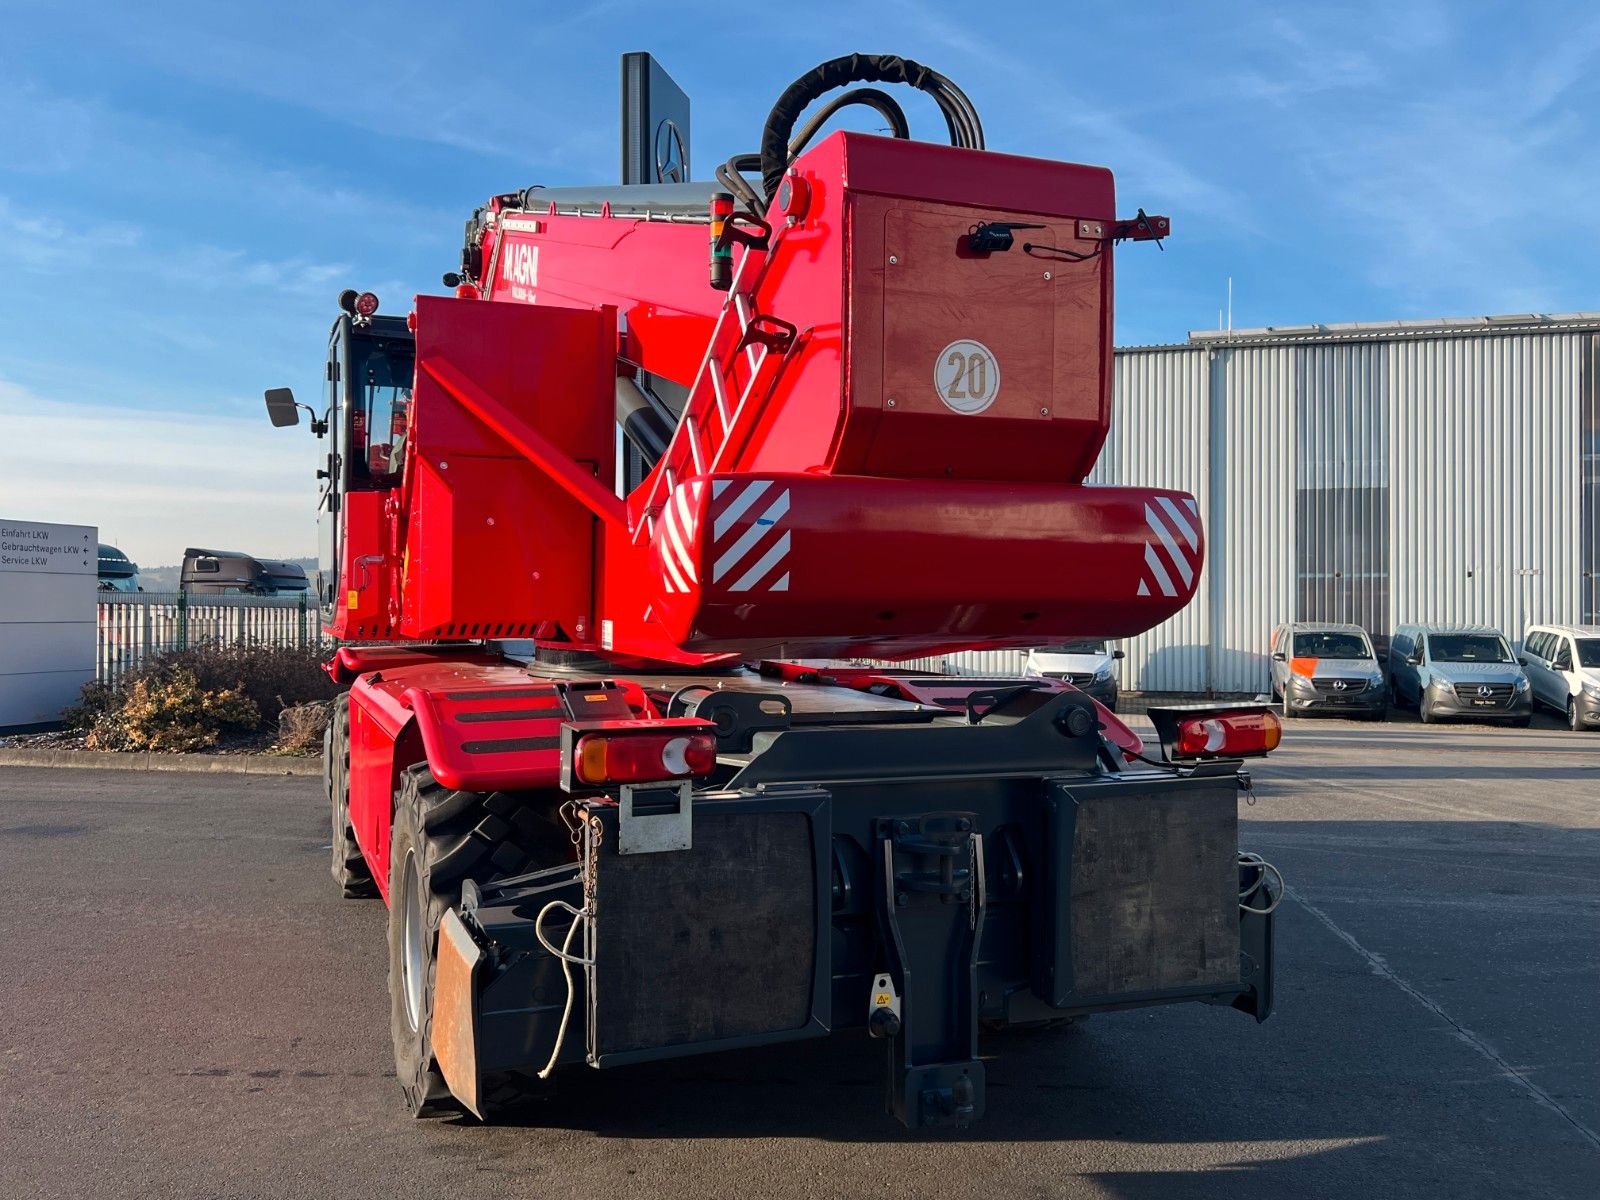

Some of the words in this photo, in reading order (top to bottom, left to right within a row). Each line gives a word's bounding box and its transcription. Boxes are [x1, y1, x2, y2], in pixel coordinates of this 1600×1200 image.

[503, 243, 539, 287] MAGNI
[948, 351, 986, 399] 20
[1, 528, 31, 539] Einfahrt
[32, 530, 49, 540] LKW
[1, 541, 61, 555] Gebrauchtwagen
[63, 545, 79, 554] LKW
[1, 555, 29, 565] Service
[31, 557, 48, 566] LKW
